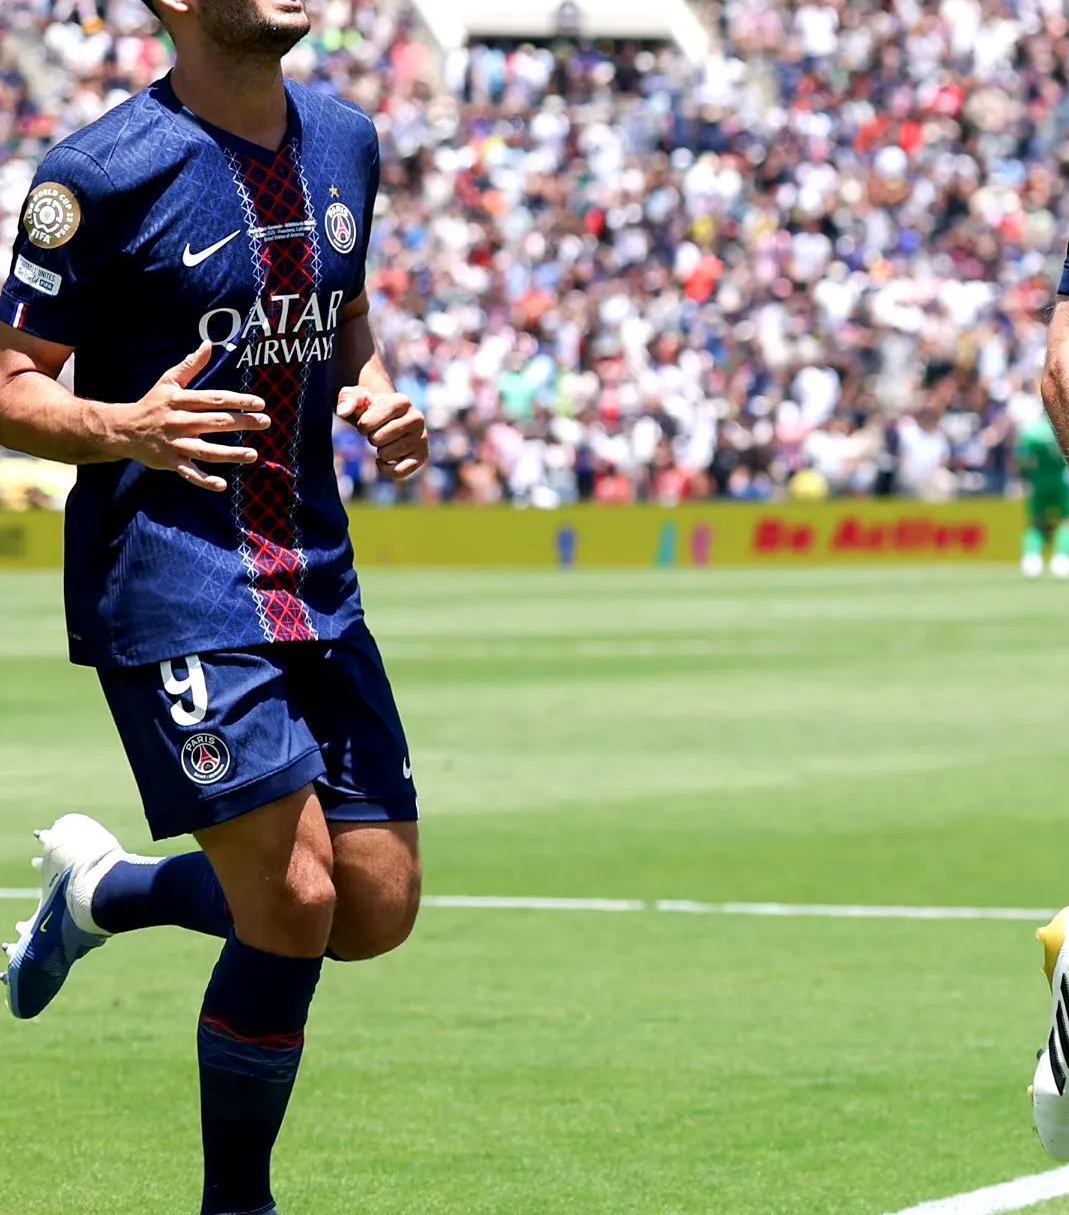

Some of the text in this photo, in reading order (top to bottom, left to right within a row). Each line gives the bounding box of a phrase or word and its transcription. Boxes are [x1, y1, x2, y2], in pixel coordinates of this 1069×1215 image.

[59, 193, 72, 210] CUP
[30, 228, 51, 244] FIFA
[198, 290, 343, 352] QATAR
[159, 653, 208, 726] 9
[185, 736, 215, 752] PARIS
